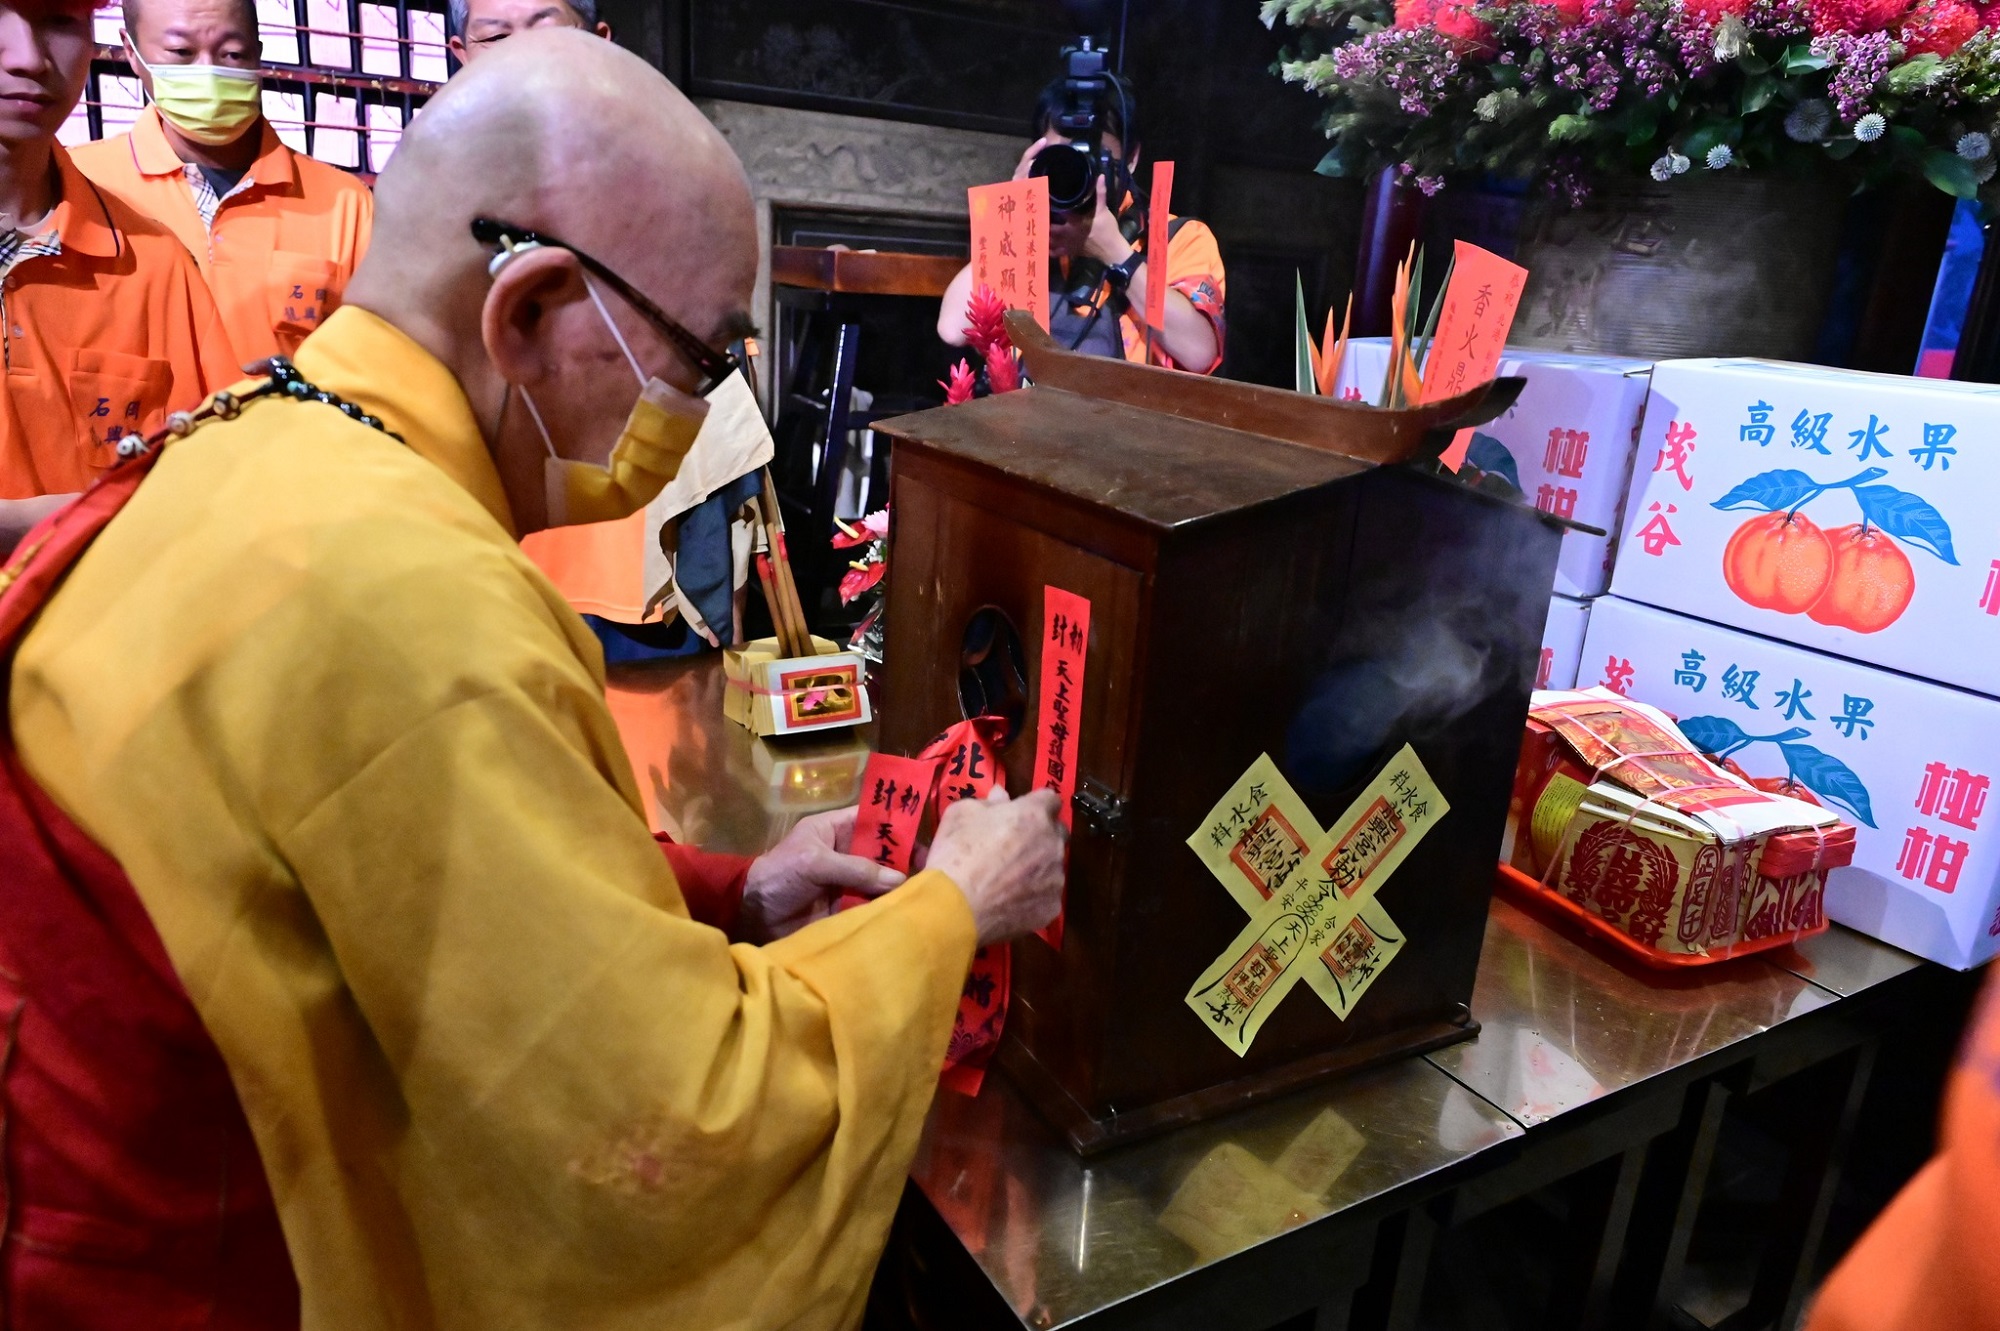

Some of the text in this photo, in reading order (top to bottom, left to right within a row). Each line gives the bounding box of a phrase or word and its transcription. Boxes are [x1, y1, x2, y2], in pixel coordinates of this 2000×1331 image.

[997, 195, 1017, 311] 神威顯
[1635, 420, 1698, 556] 茂谷
[1739, 399, 1958, 471] 高級水果
[1674, 648, 1875, 741] 高級水果
[1896, 760, 1990, 894] 椪柑
